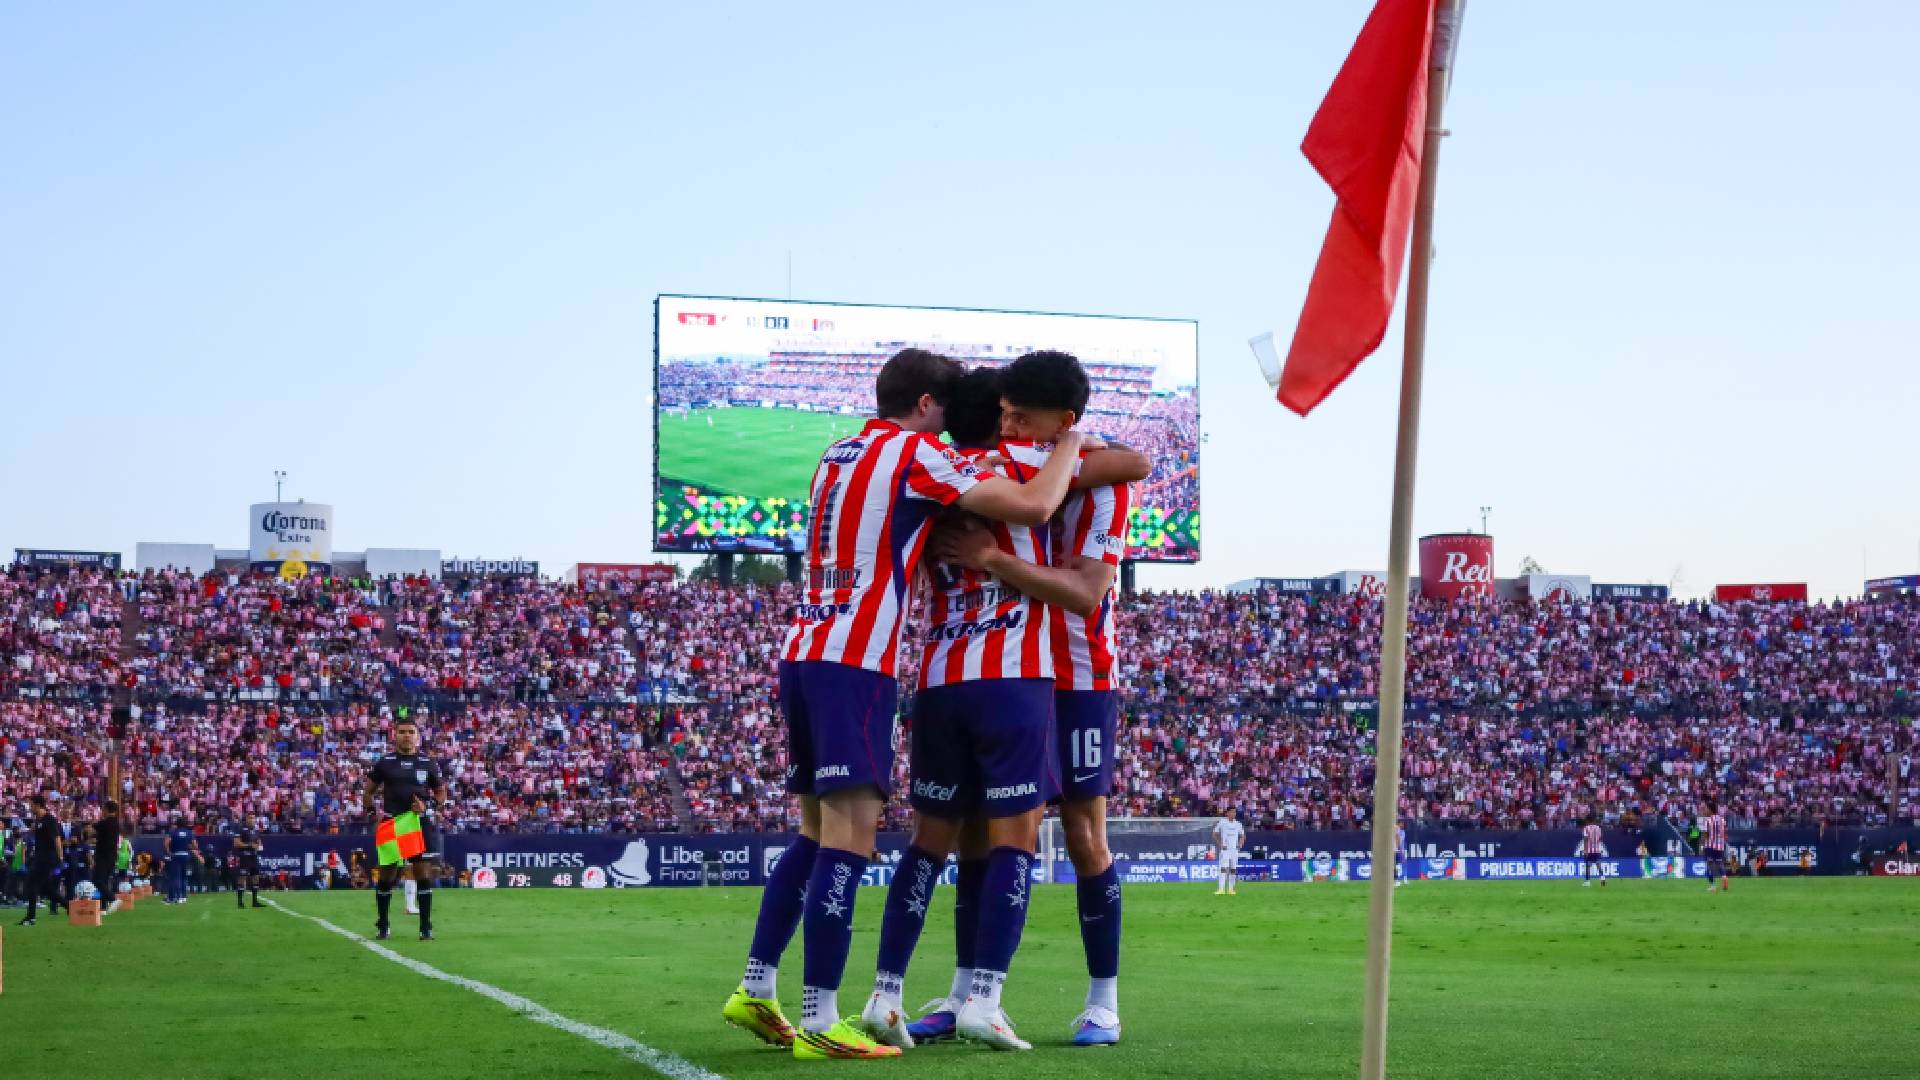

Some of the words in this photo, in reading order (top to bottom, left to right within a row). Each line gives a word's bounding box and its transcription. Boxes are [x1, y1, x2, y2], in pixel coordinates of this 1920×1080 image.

[262, 511, 326, 533] Corona
[1439, 552, 1493, 585] Red
[1360, 574, 1388, 596] Re
[1072, 728, 1101, 768] 16
[660, 845, 750, 864] Libead
[1479, 862, 1534, 877] PRUEBA
[1884, 860, 1920, 875] Clar
